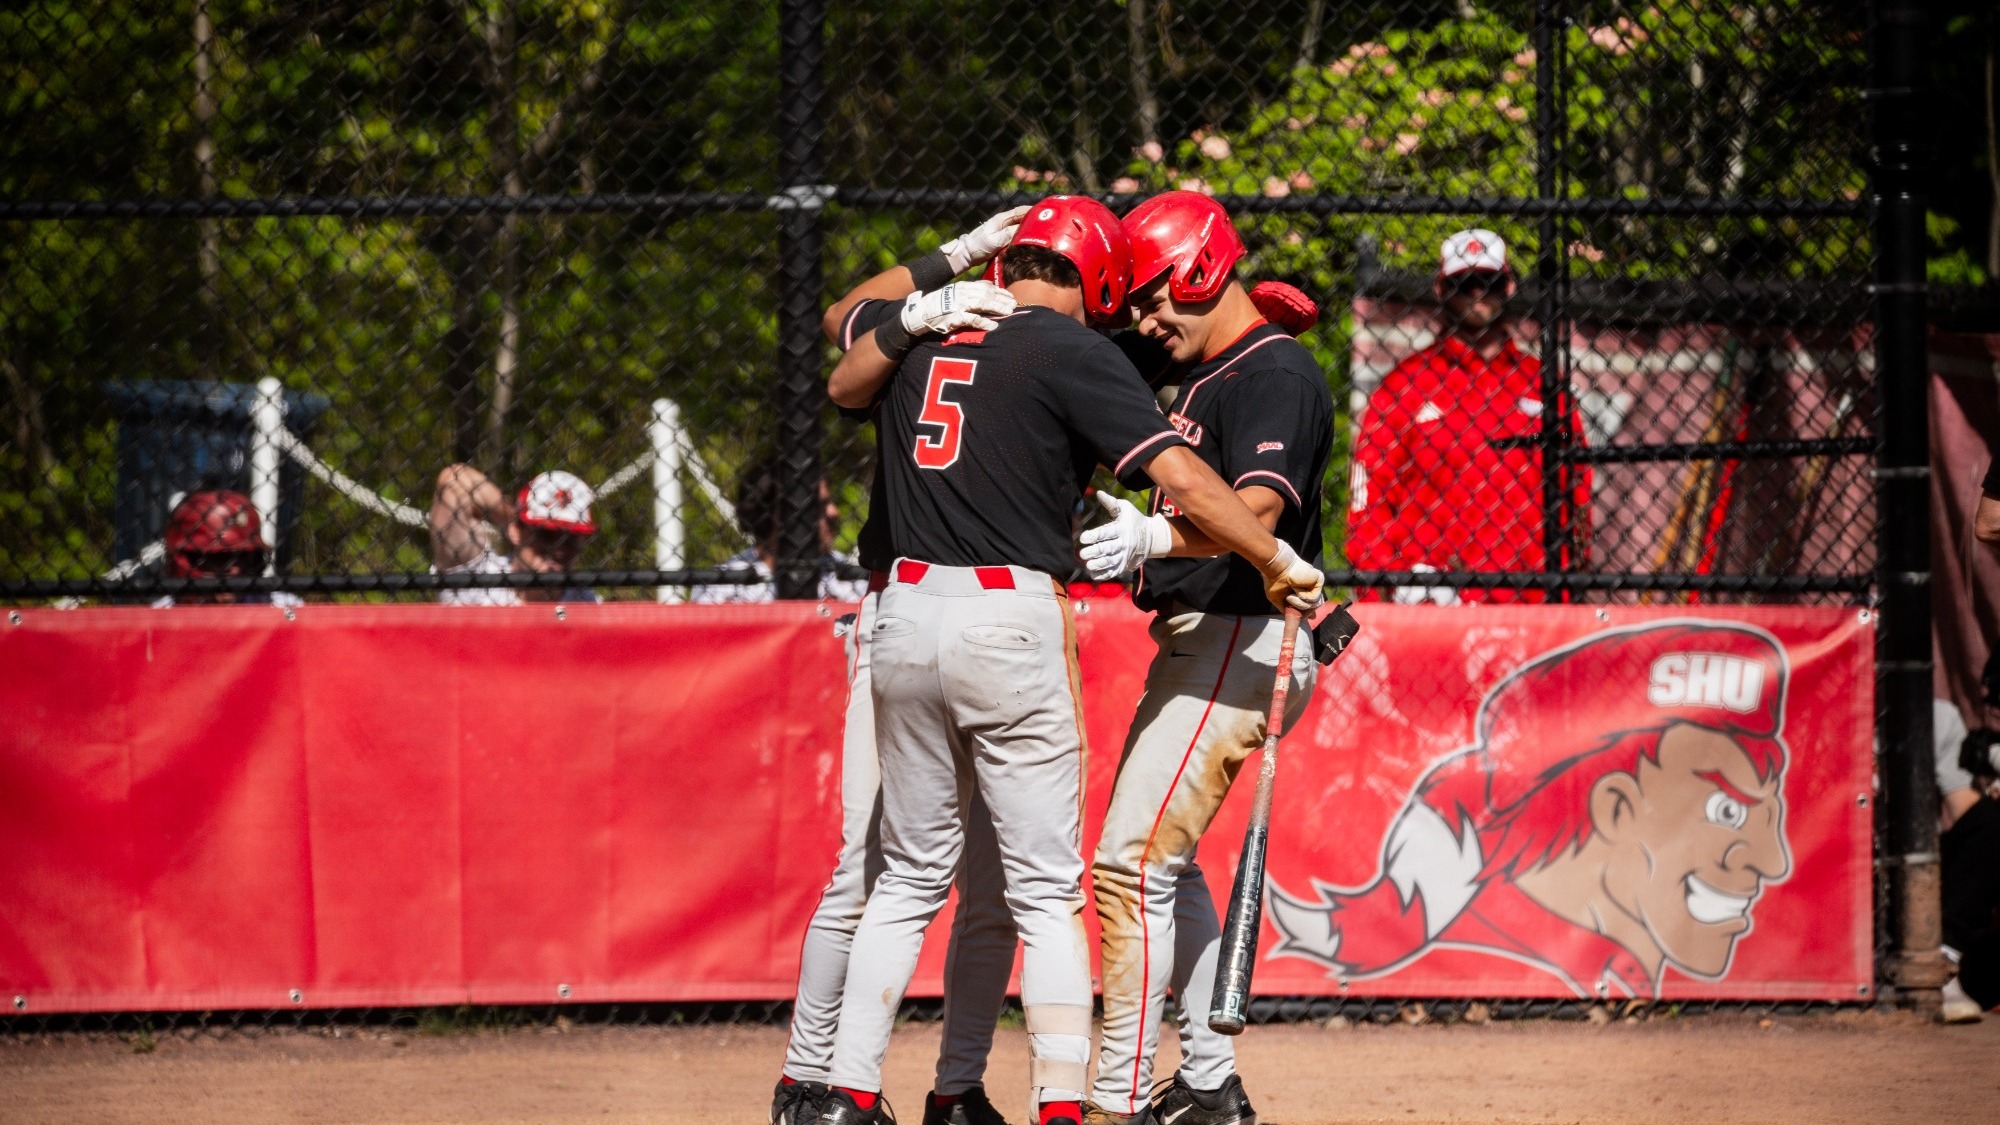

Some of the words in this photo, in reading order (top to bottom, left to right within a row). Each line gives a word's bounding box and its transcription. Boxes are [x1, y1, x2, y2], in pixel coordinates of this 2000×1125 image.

[913, 356, 978, 470] 5
[1168, 411, 1203, 447] FIELD
[1647, 651, 1765, 715] SHU
